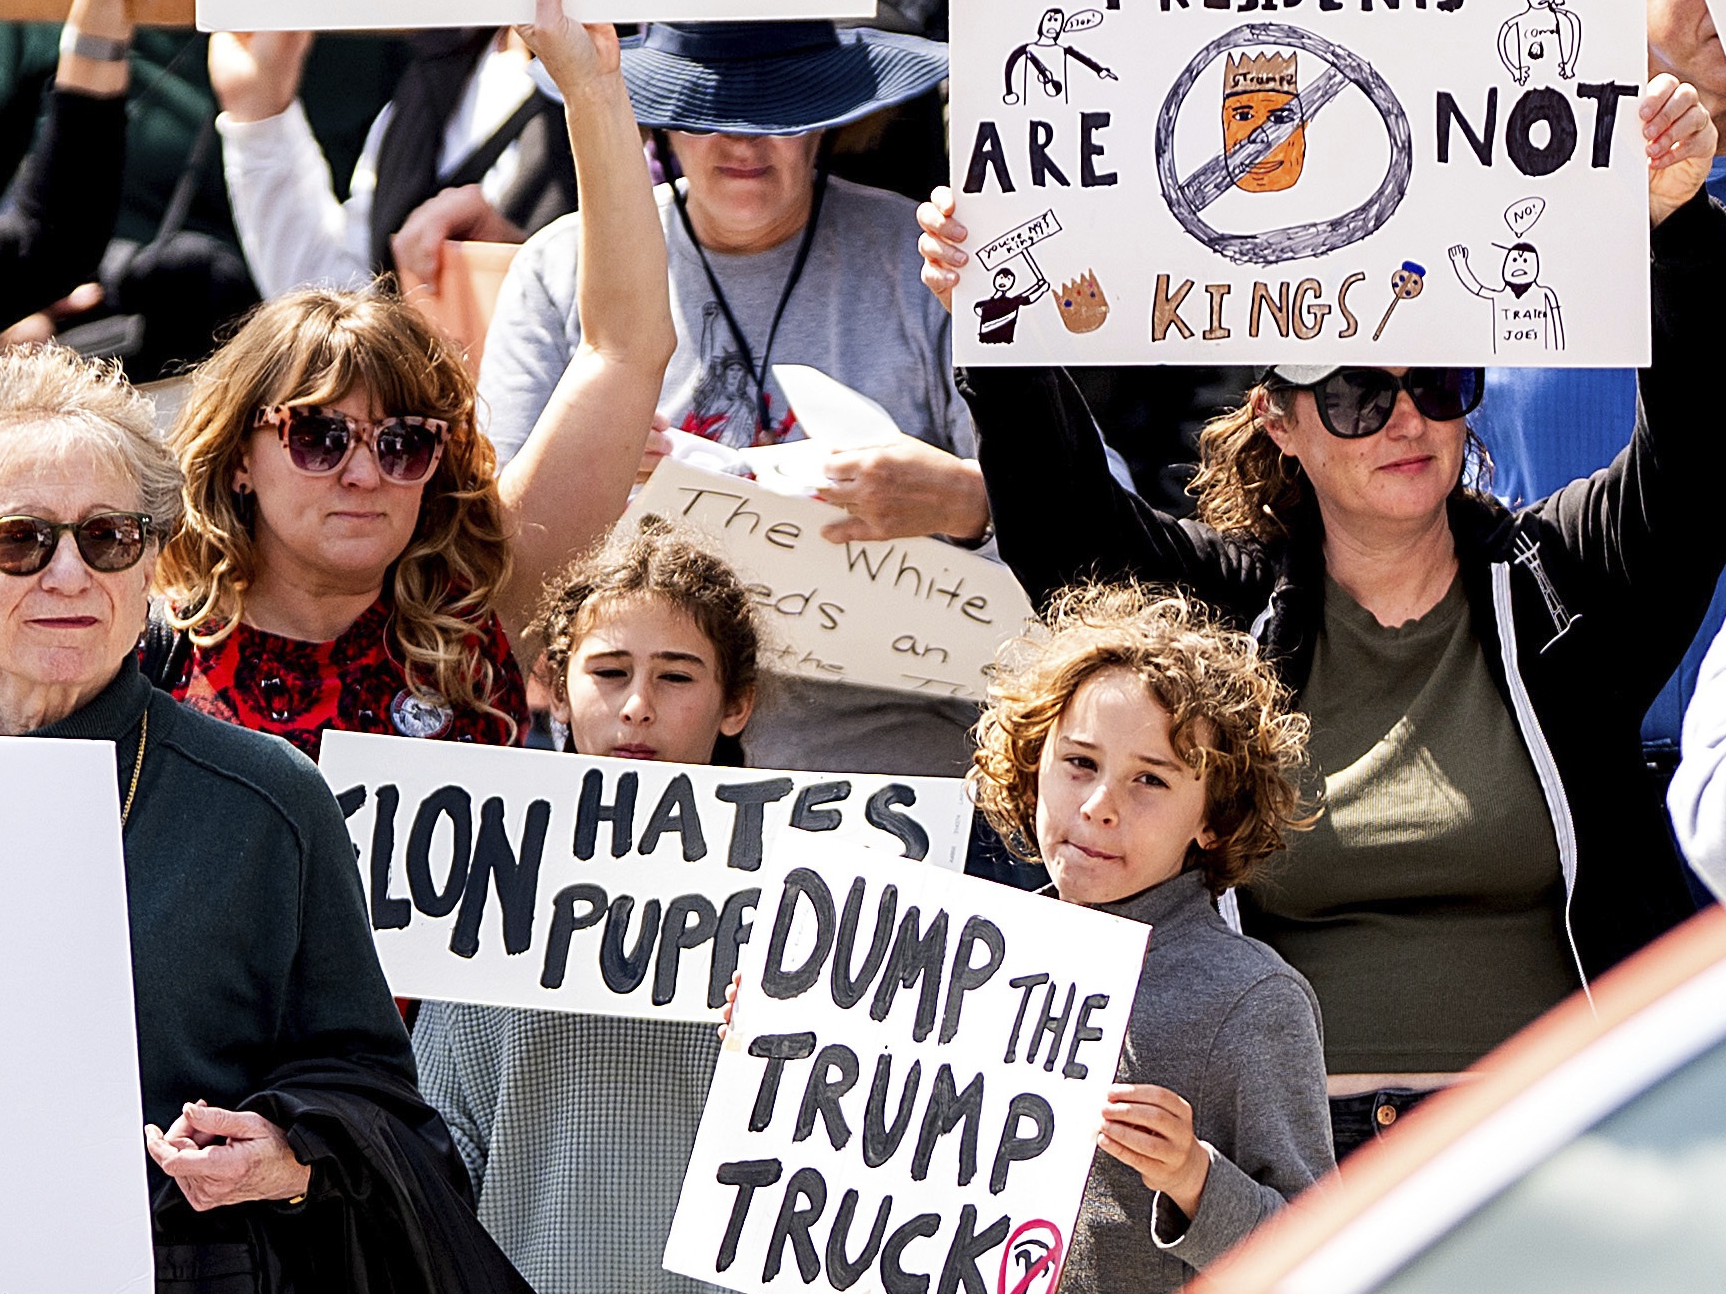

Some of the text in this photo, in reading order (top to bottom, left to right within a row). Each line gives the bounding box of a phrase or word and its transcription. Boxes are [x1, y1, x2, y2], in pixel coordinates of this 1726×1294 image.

[962, 82, 1641, 196] ARE NOT
[1151, 271, 1366, 343] KINGS
[678, 487, 992, 625] The White
[892, 635, 949, 664] an
[572, 768, 931, 872] HATES
[760, 867, 1110, 1081] DUMP THE
[747, 1030, 1054, 1195] TRUMP
